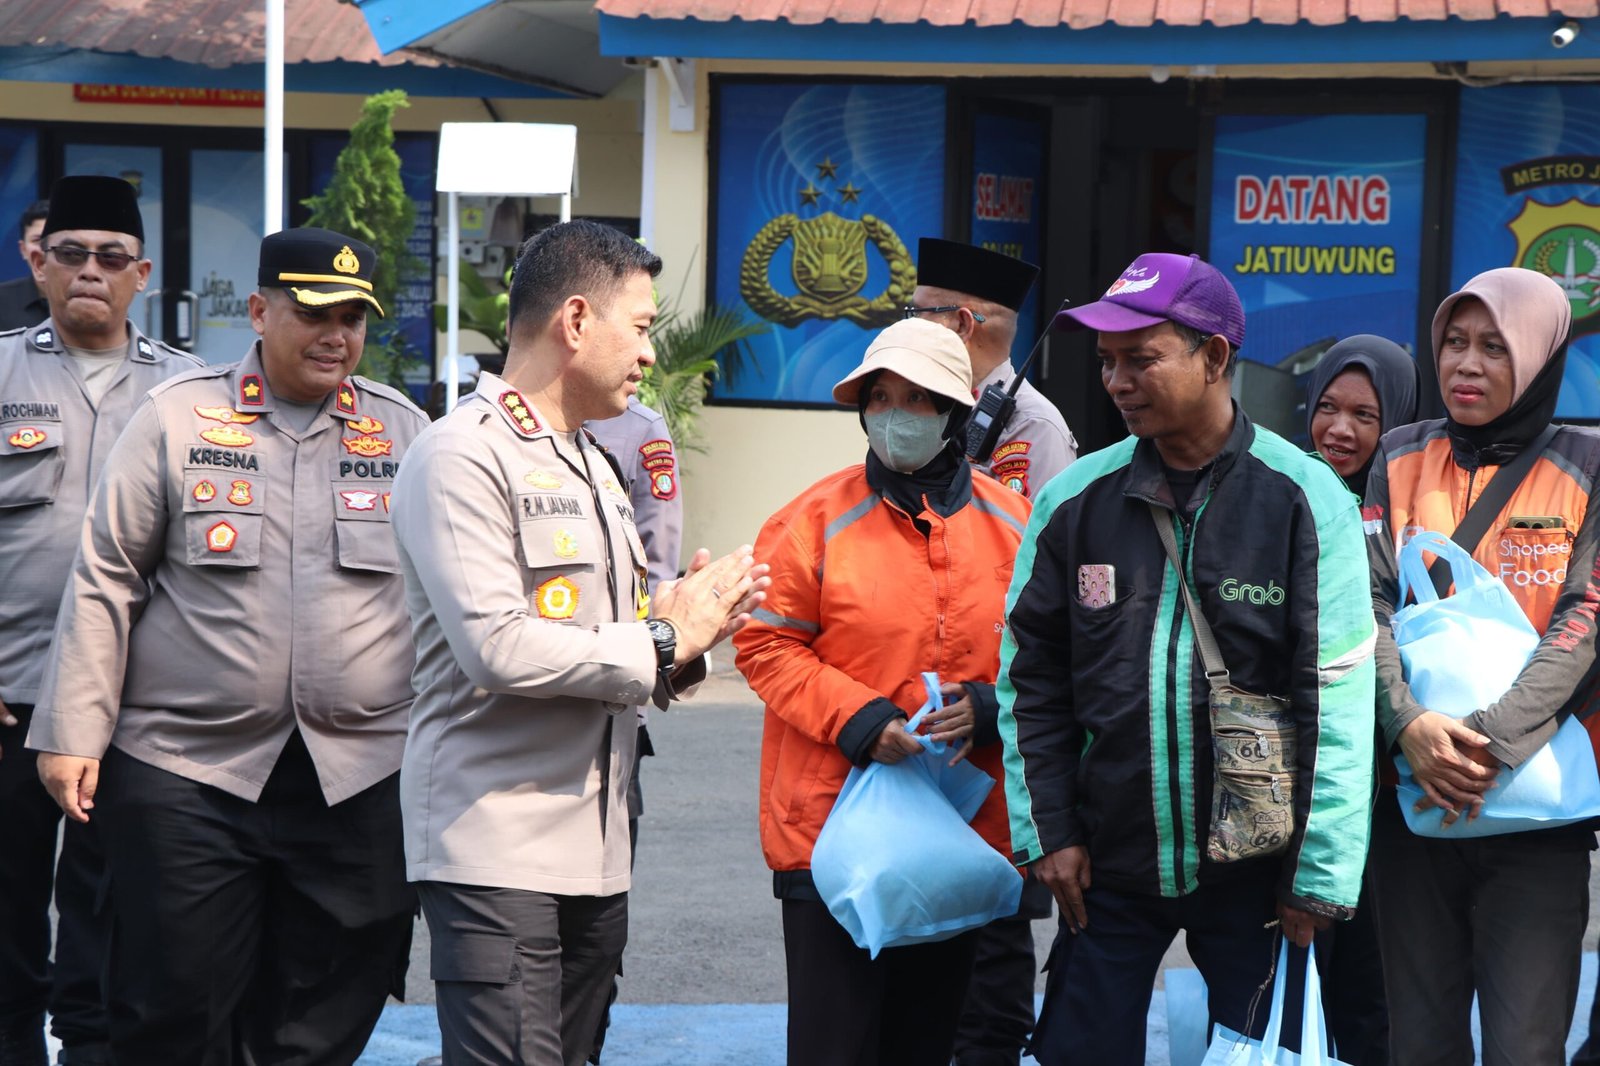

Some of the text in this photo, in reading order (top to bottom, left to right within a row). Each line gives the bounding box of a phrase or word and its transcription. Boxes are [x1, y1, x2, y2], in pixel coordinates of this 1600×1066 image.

[1512, 163, 1585, 187] METRO
[977, 172, 1033, 223] SELAMAT
[1234, 175, 1390, 224] DATANG
[1235, 246, 1396, 274] JATIUWUNG
[189, 447, 259, 471] KRESNA
[1500, 539, 1569, 561] Shopee
[1500, 560, 1568, 587] Food
[1219, 578, 1285, 605] Grab
